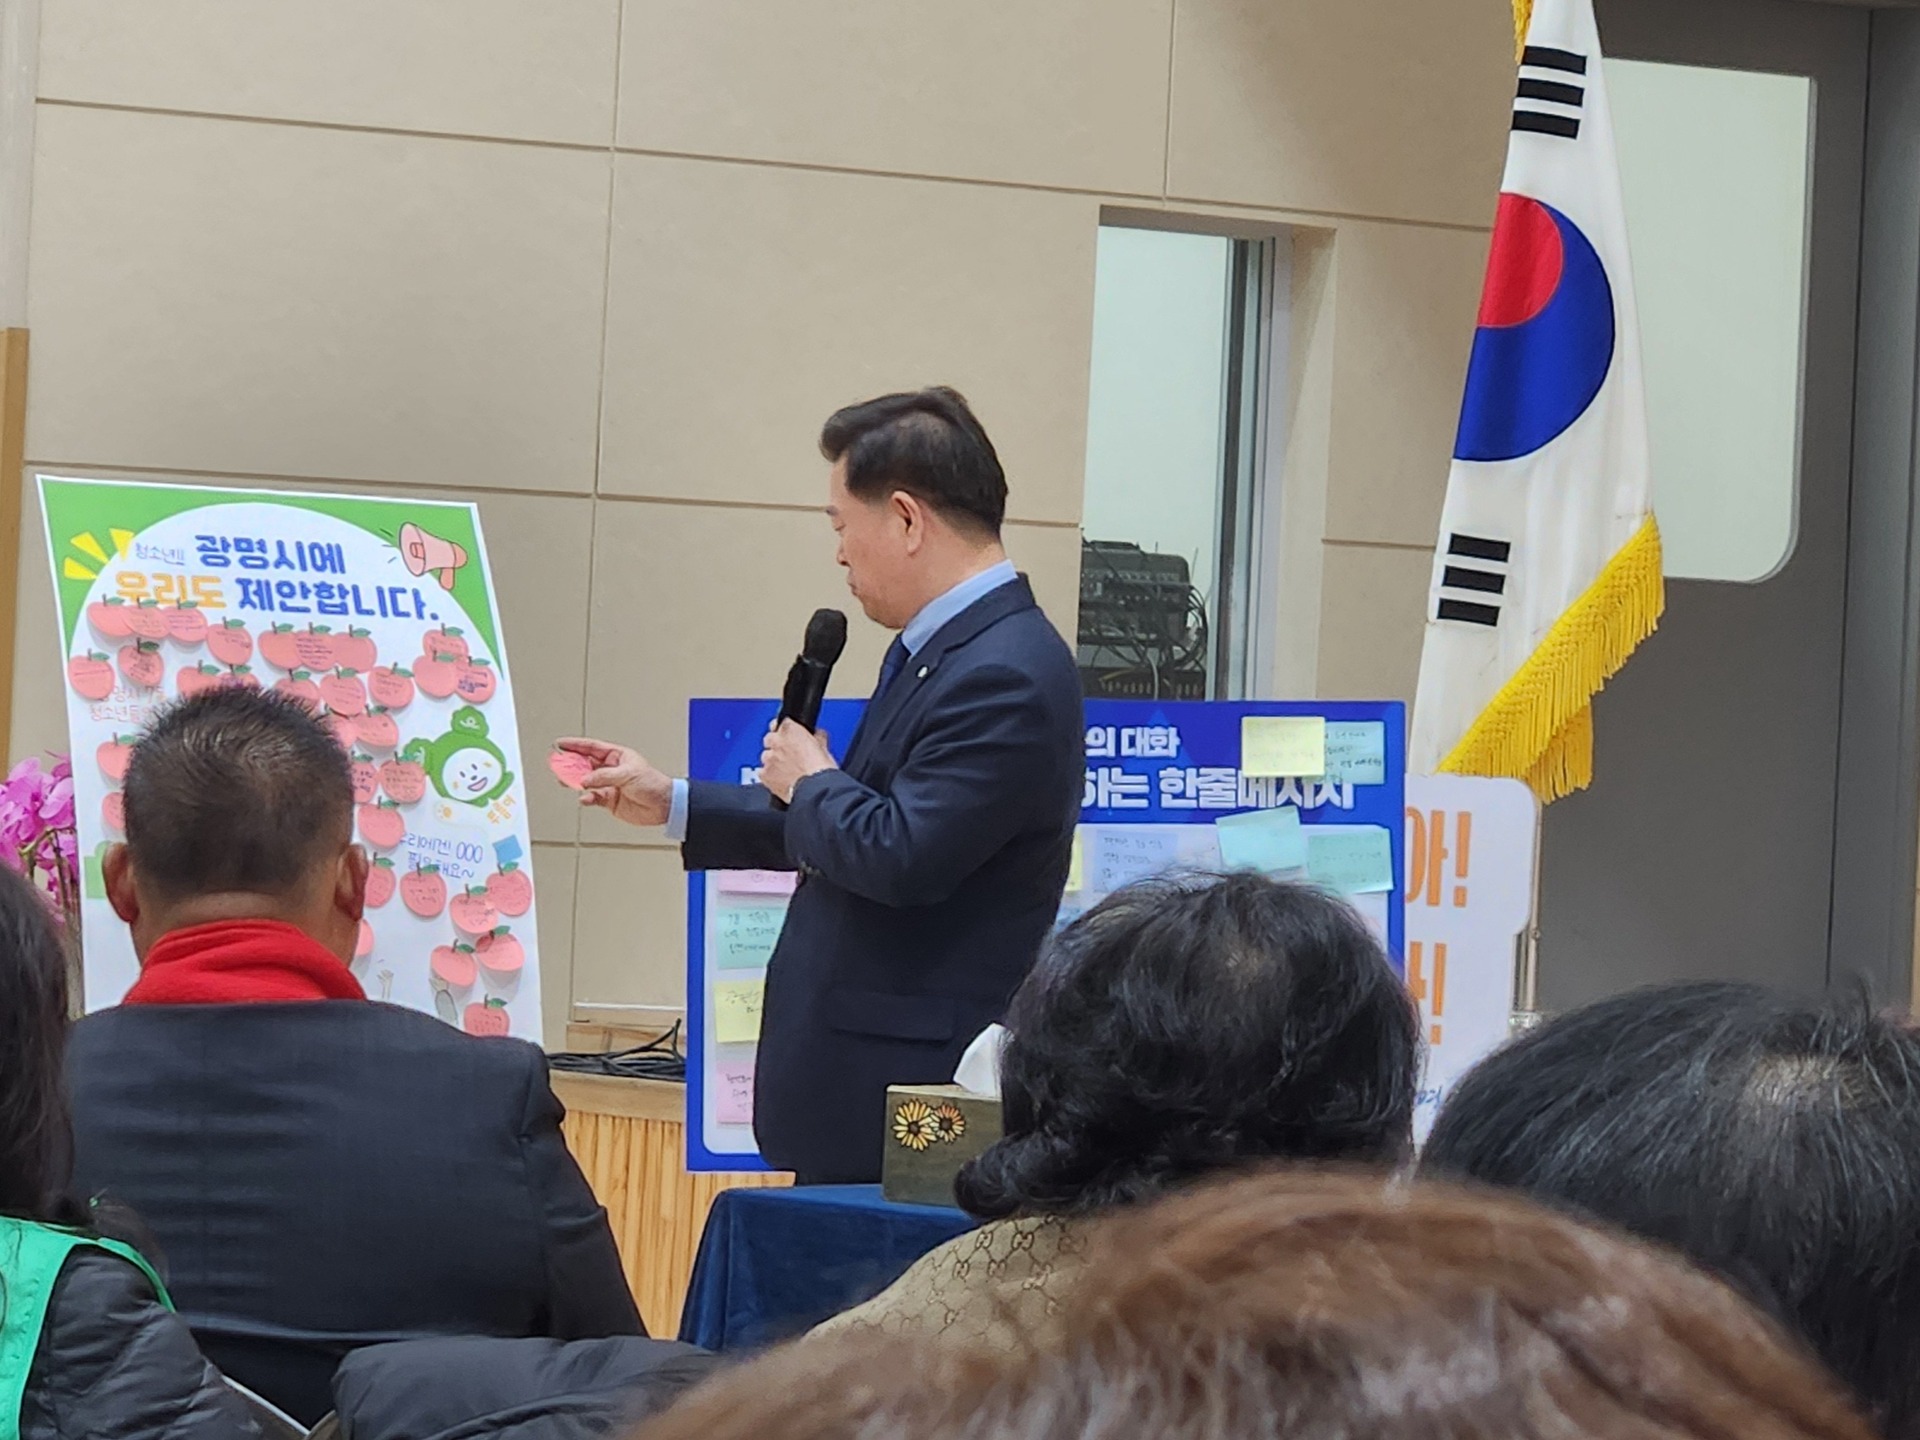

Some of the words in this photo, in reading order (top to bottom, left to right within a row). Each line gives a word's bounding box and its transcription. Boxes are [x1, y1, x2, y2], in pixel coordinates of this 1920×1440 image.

[195, 534, 347, 575] 광명시에
[115, 571, 228, 609] 우리도
[235, 577, 440, 621] 제안합니다.
[1121, 726, 1181, 758] 대화
[400, 831, 452, 857] 리에겐
